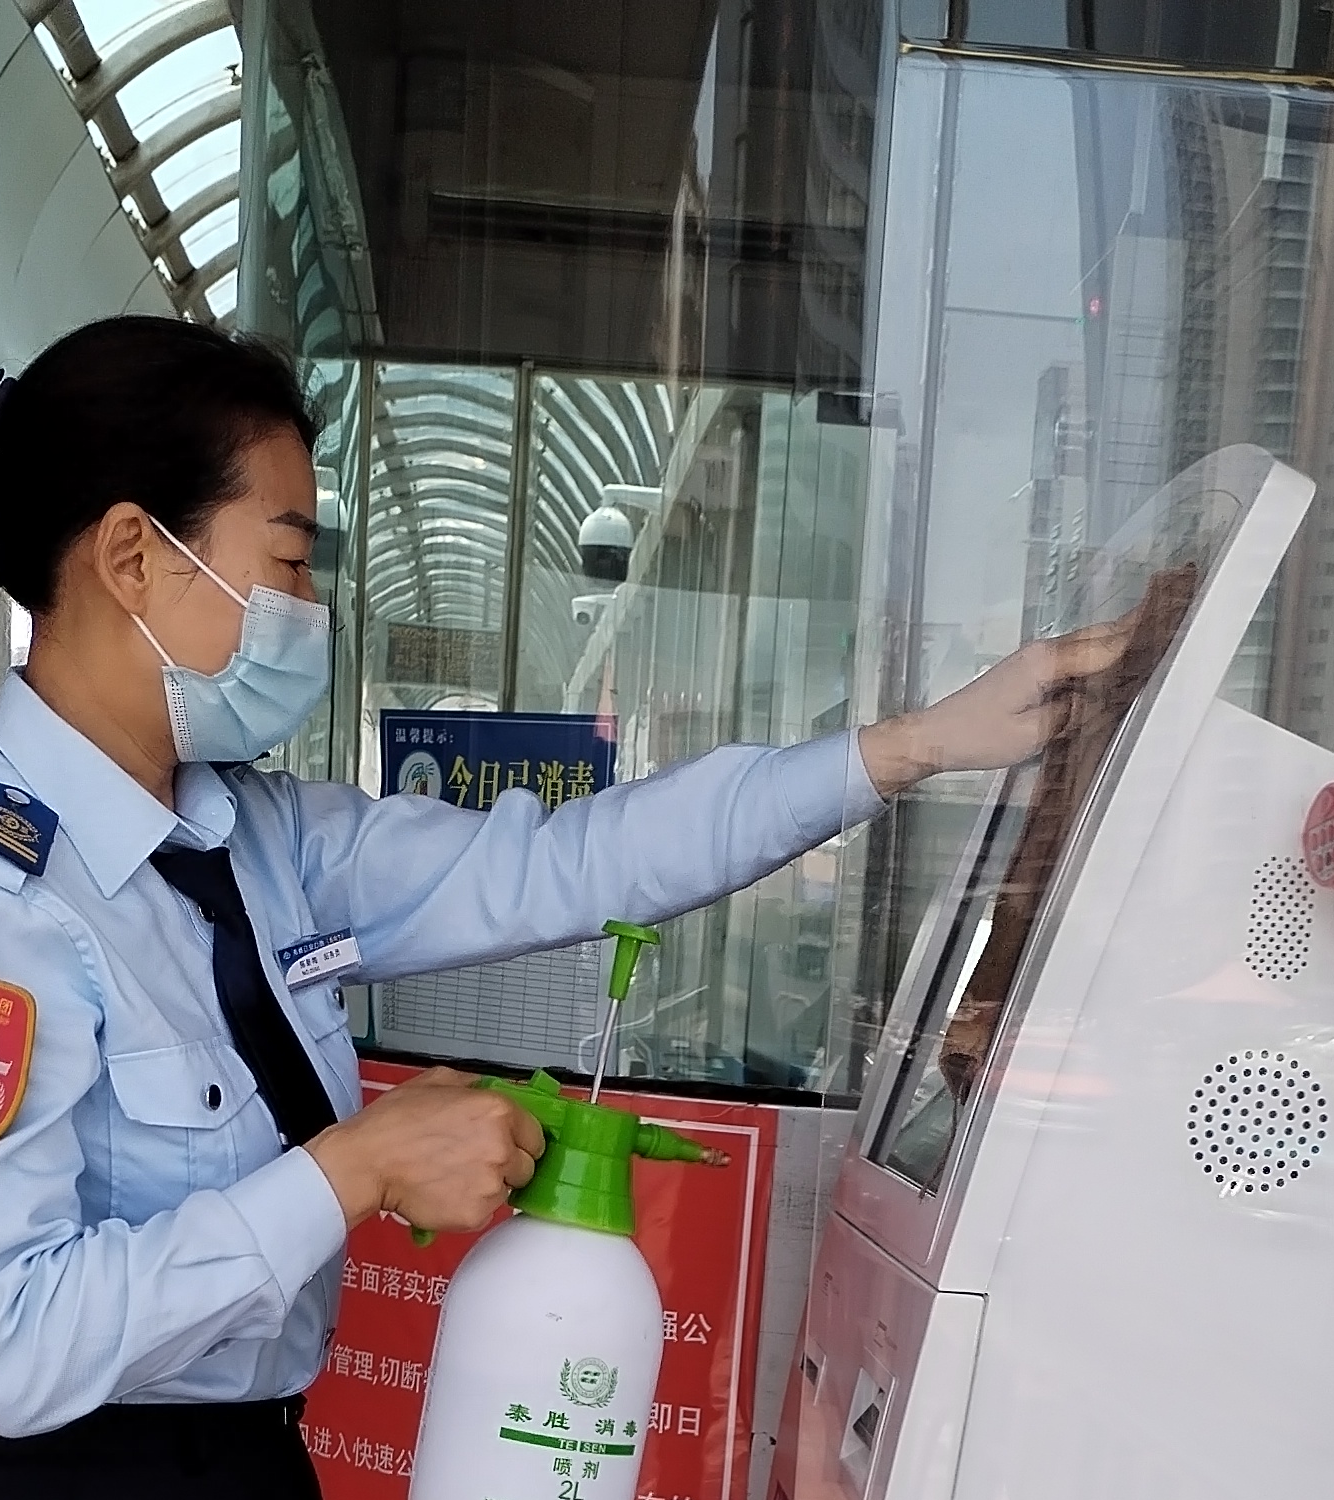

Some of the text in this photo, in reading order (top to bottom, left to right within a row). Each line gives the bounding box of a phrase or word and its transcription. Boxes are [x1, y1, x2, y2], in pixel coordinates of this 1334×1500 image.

[342, 1256, 451, 1306] 全面落实疫
[327, 1343, 432, 1394] 管理,切断
[553, 1457, 600, 1480] 喷剂
